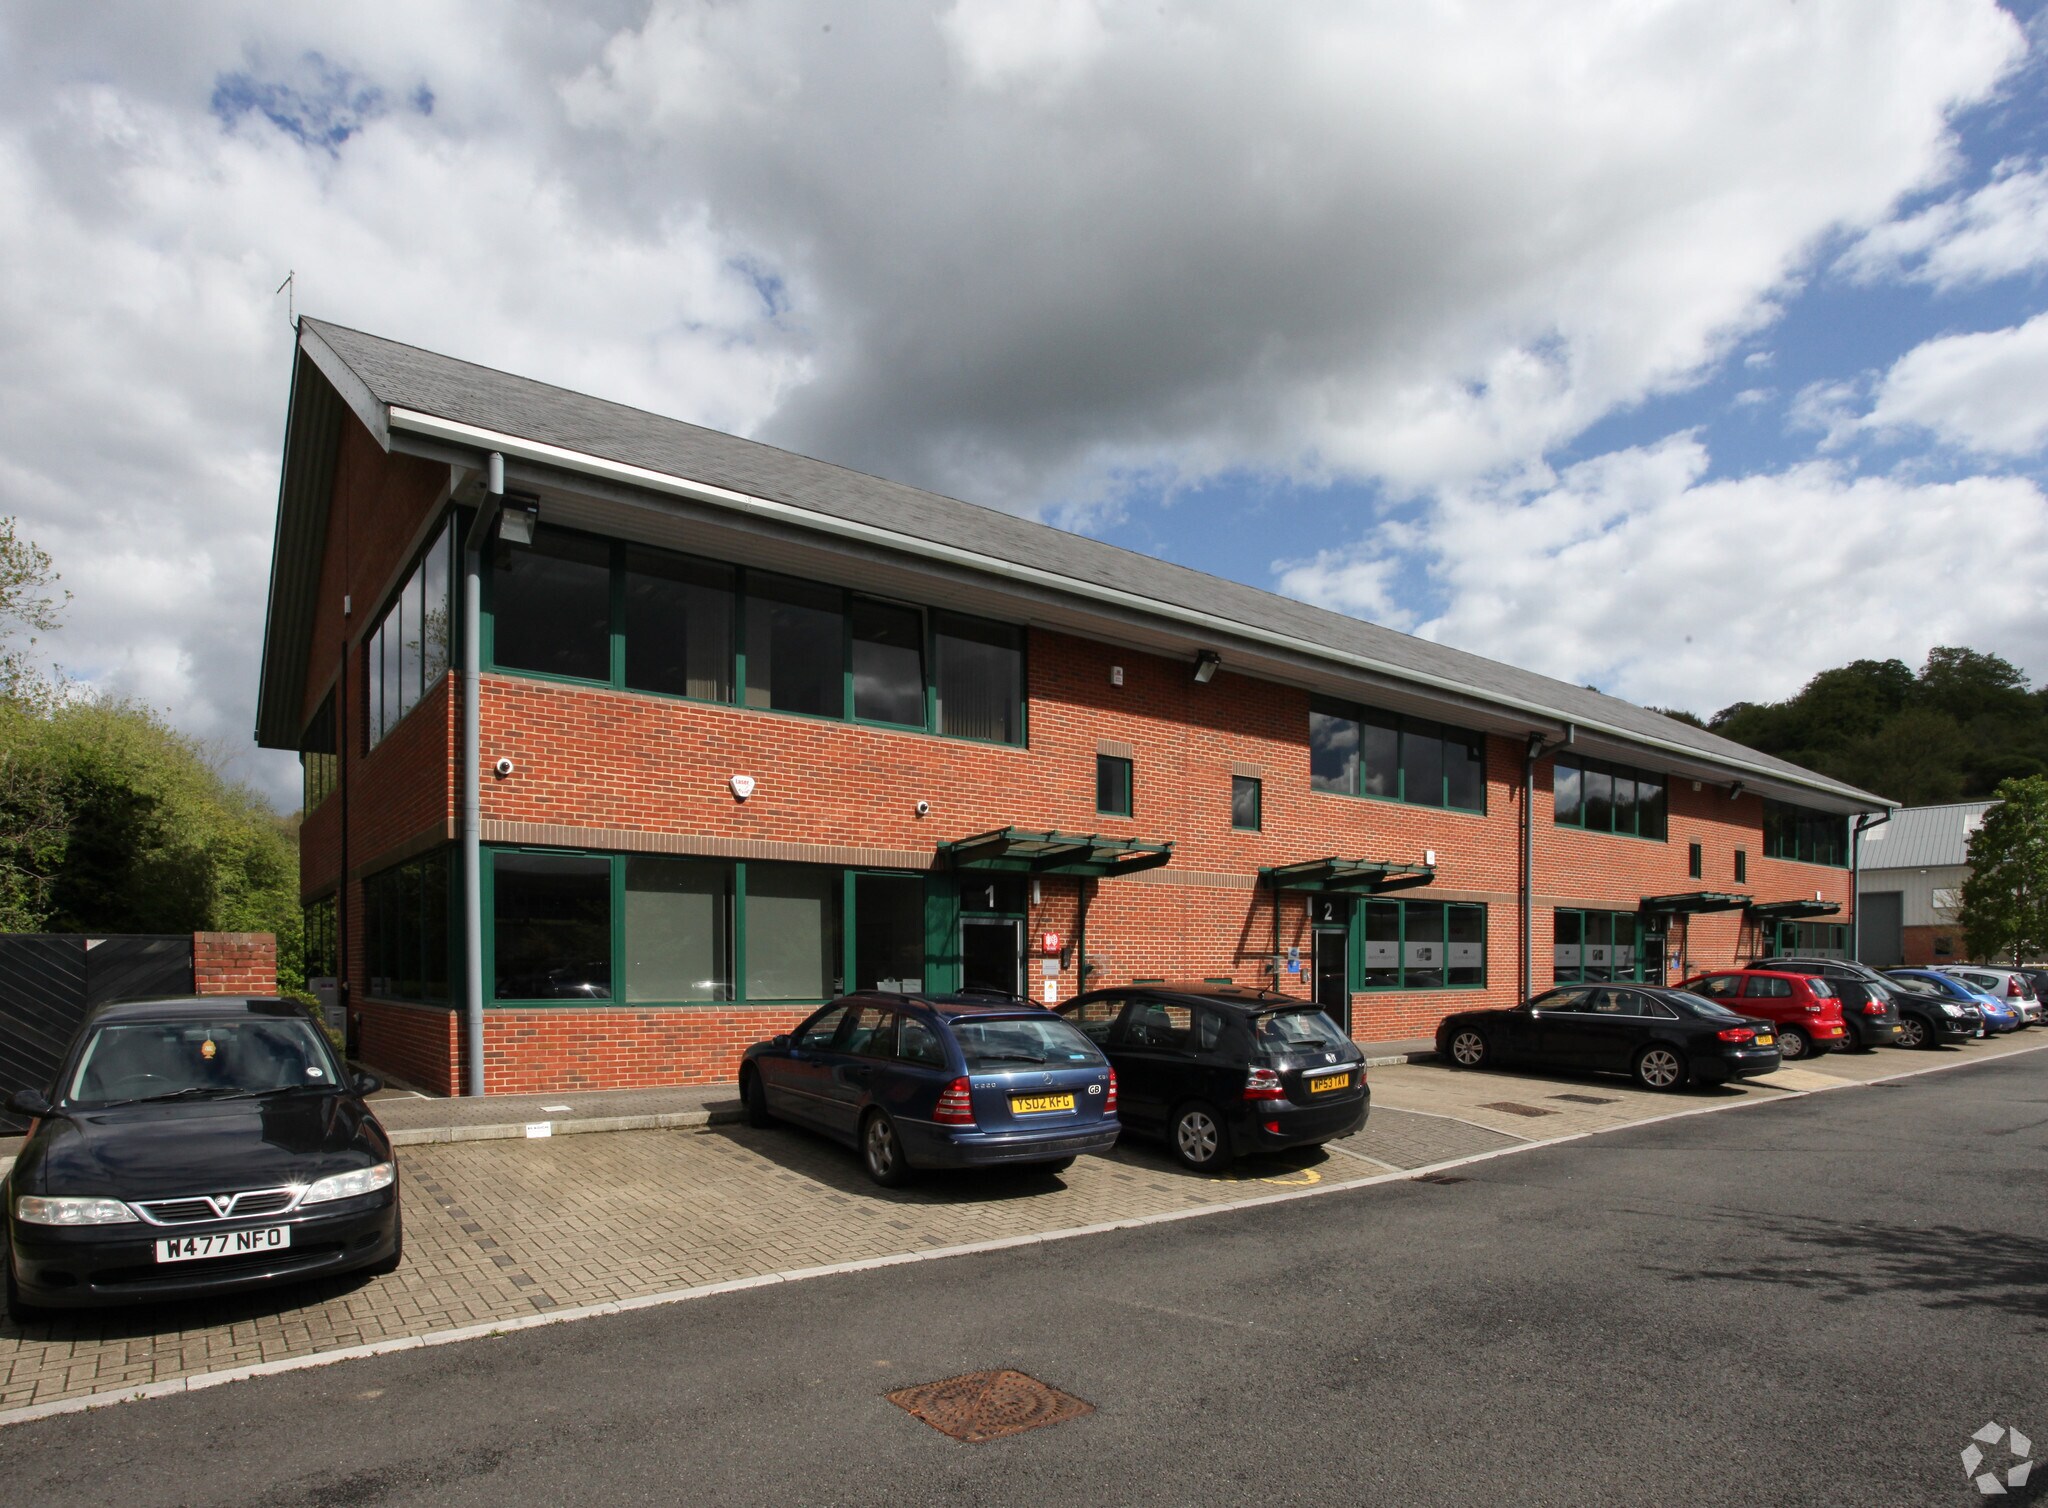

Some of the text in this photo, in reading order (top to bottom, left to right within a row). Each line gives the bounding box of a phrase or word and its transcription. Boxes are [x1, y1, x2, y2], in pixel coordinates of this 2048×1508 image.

[985, 884, 994, 908] 1
[1324, 902, 1333, 921] 2
[1651, 918, 1657, 932] 3
[1089, 1085, 1100, 1095] GB
[1314, 1075, 1346, 1090] WP53 TAV
[1017, 1095, 1070, 1110] YS02 KFG
[167, 1228, 282, 1258] W477 NFO
